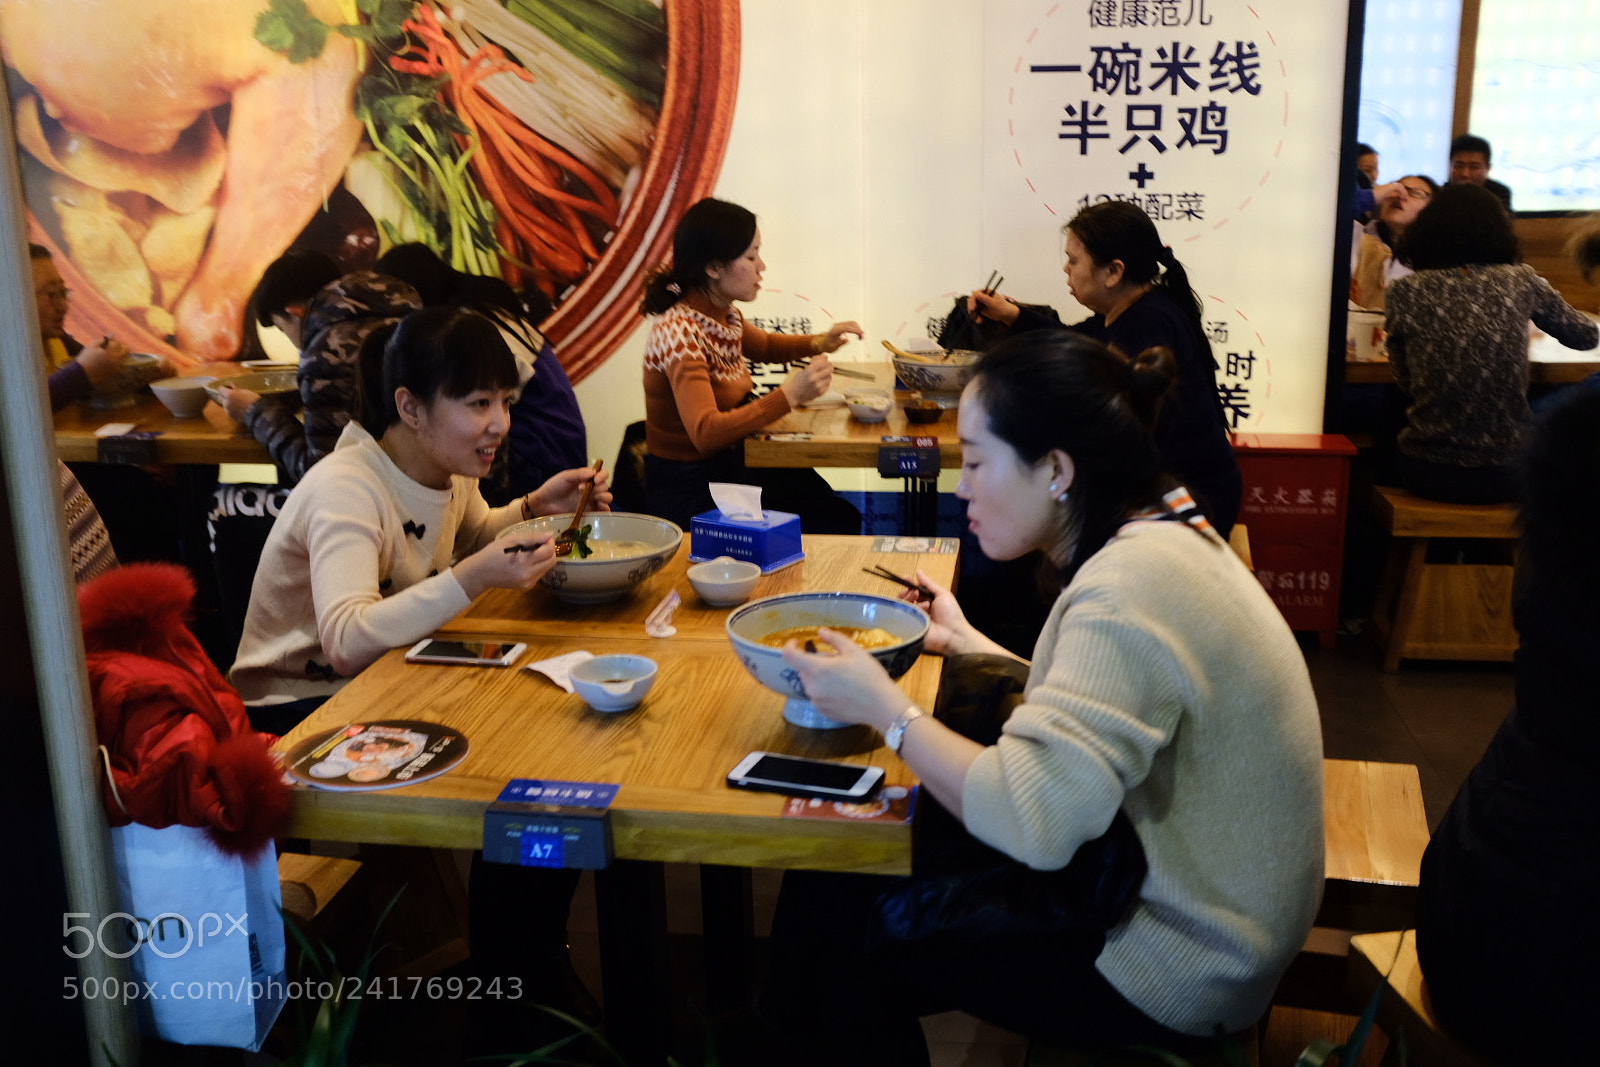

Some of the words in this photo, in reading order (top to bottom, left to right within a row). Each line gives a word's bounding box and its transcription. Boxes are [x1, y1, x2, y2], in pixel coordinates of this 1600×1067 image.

[1088, 0, 1213, 28] 健康范儿
[1030, 41, 1262, 96] 一碗米线
[1058, 101, 1228, 155] 半只鸡
[529, 843, 554, 859] A7
